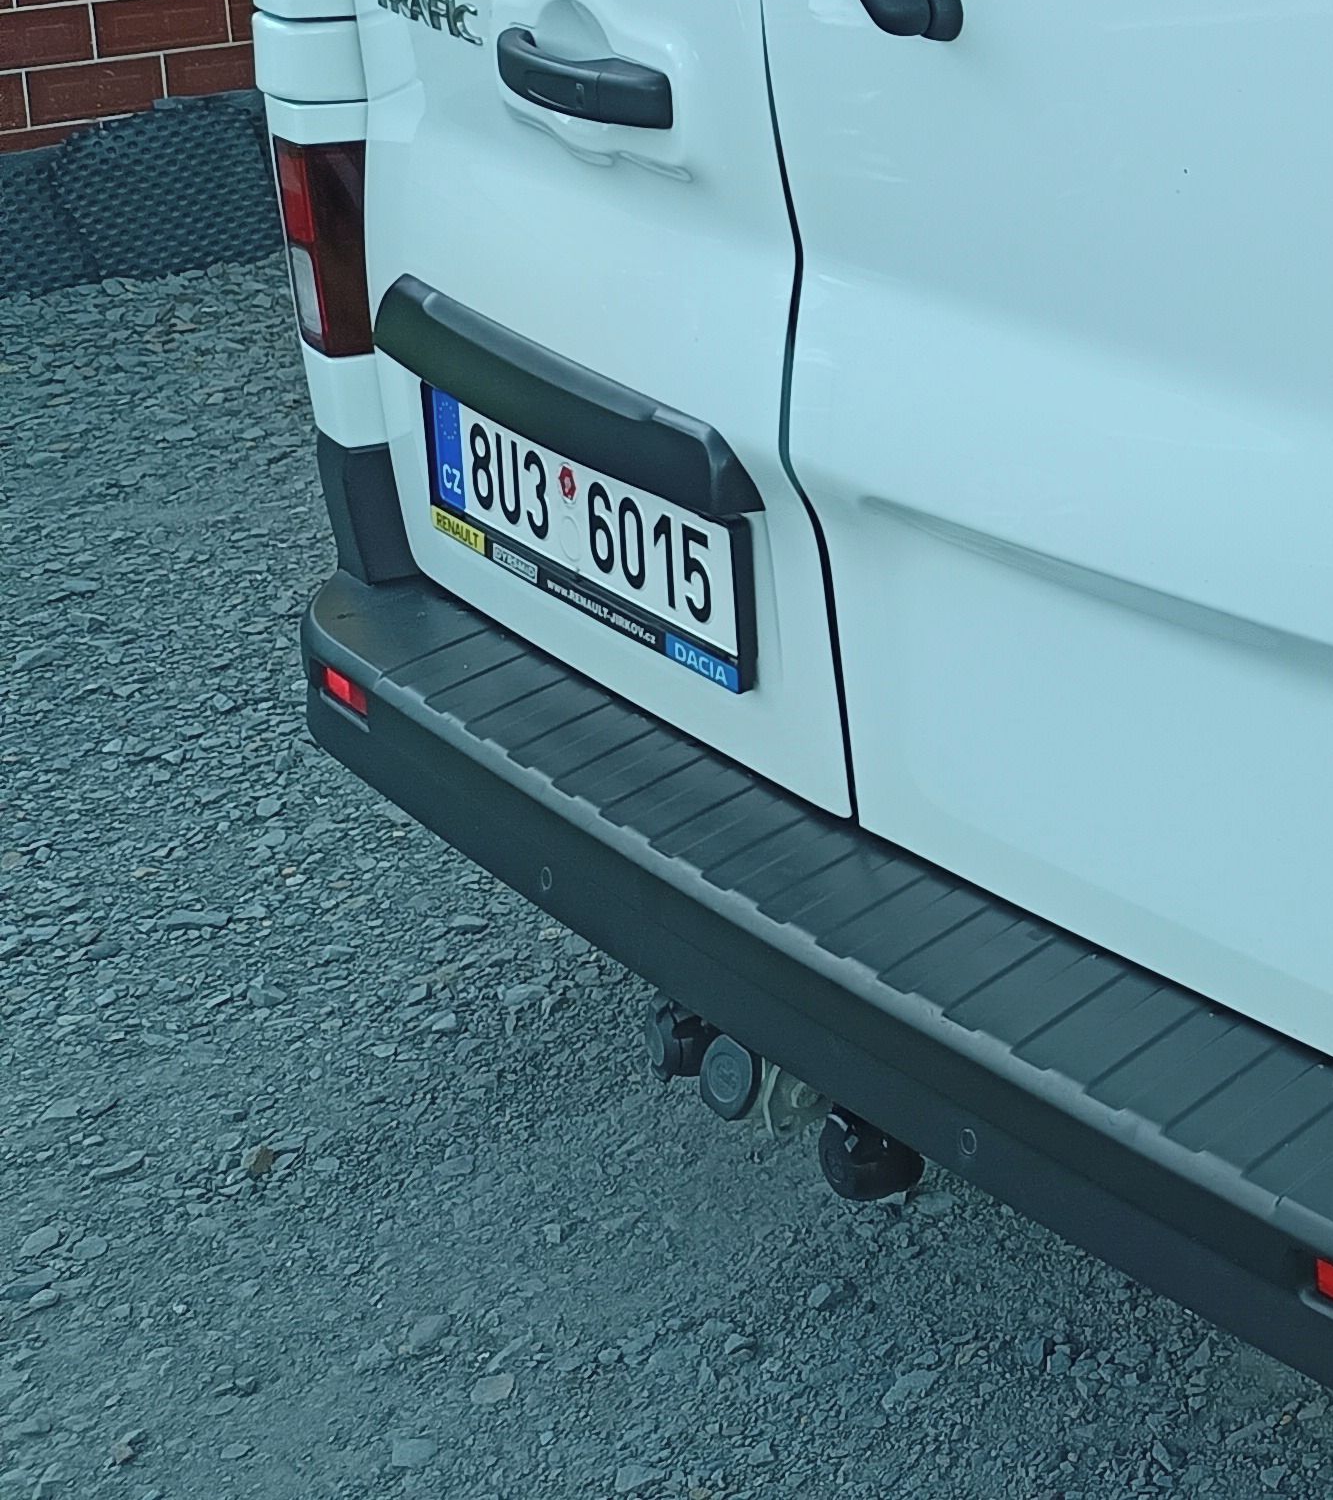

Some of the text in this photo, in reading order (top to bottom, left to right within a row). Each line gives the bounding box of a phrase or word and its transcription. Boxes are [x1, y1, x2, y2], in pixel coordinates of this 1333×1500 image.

[443, 464, 461, 494] CZ
[436, 512, 479, 548] RENAULT
[470, 422, 711, 623] 8U3 6015
[674, 642, 728, 686] DACIA
